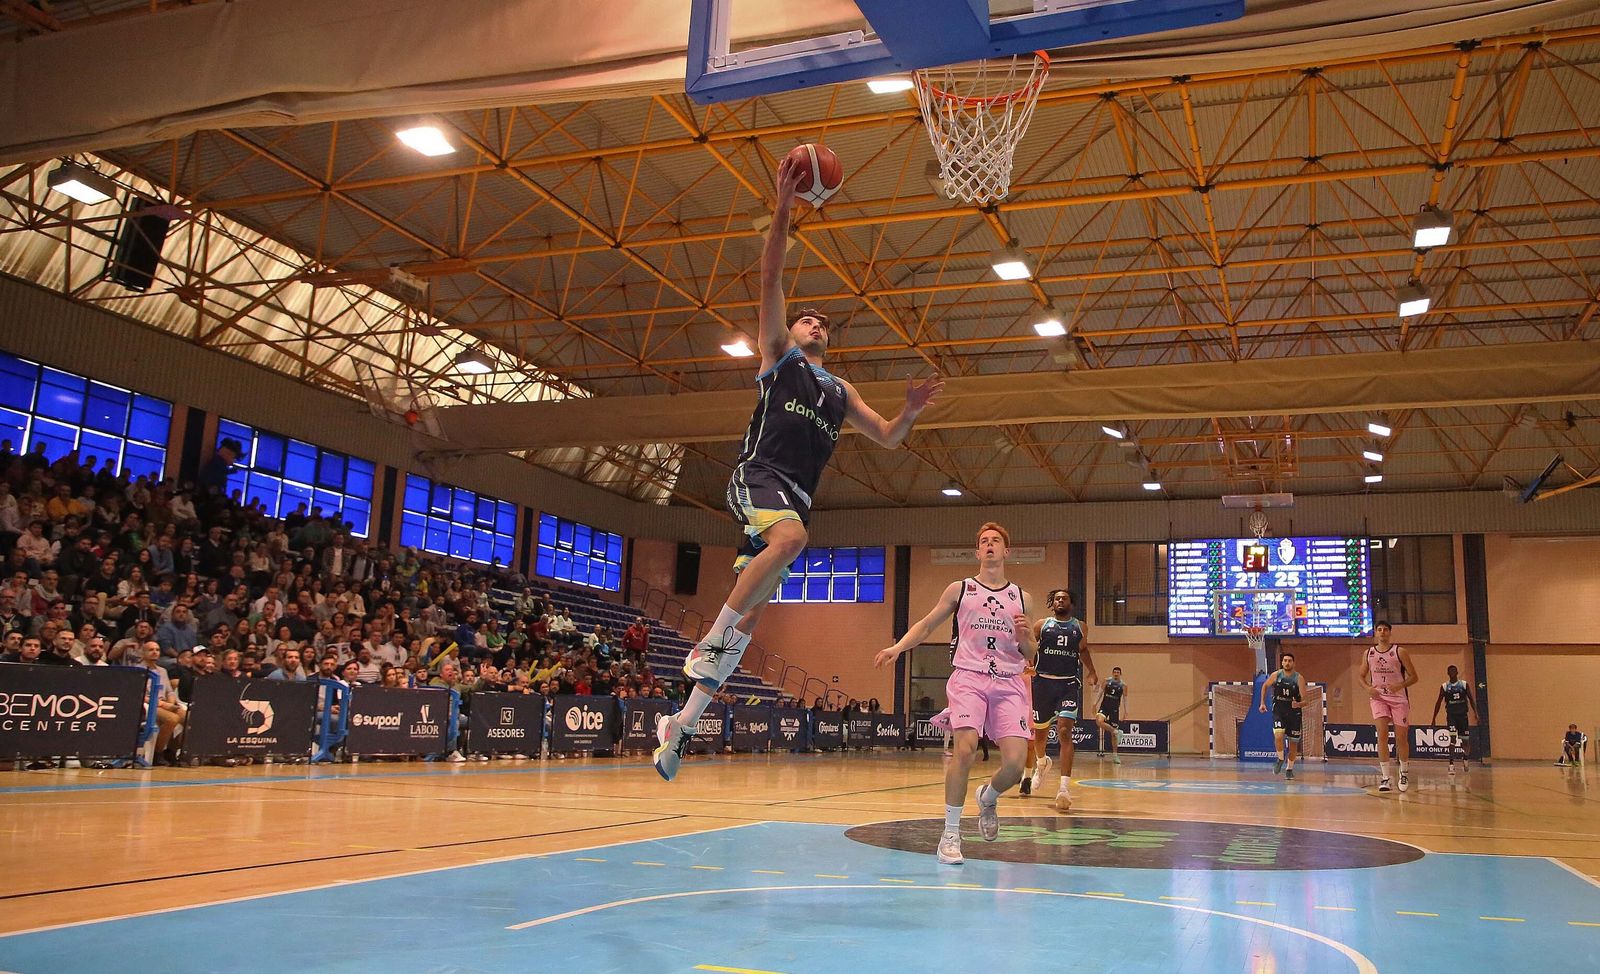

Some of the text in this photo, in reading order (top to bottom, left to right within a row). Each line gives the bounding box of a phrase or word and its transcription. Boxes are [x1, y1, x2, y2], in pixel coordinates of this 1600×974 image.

[777, 490, 789, 505] 1
[1246, 554, 1265, 568] 21
[1235, 572, 1260, 588] 27
[1274, 571, 1300, 587] 25
[1235, 607, 1243, 617] 2
[1295, 606, 1303, 617] 5
[970, 623, 1013, 635] PONFERRADA
[987, 636, 997, 650] 8
[1056, 635, 1068, 647] 21
[1044, 646, 1077, 658] damex.io
[2, 720, 97, 732] CENTER
[363, 712, 403, 730] surpool
[410, 724, 439, 735] LABOR
[487, 728, 525, 738] ASESORES
[240, 736, 278, 745] ESQUINA
